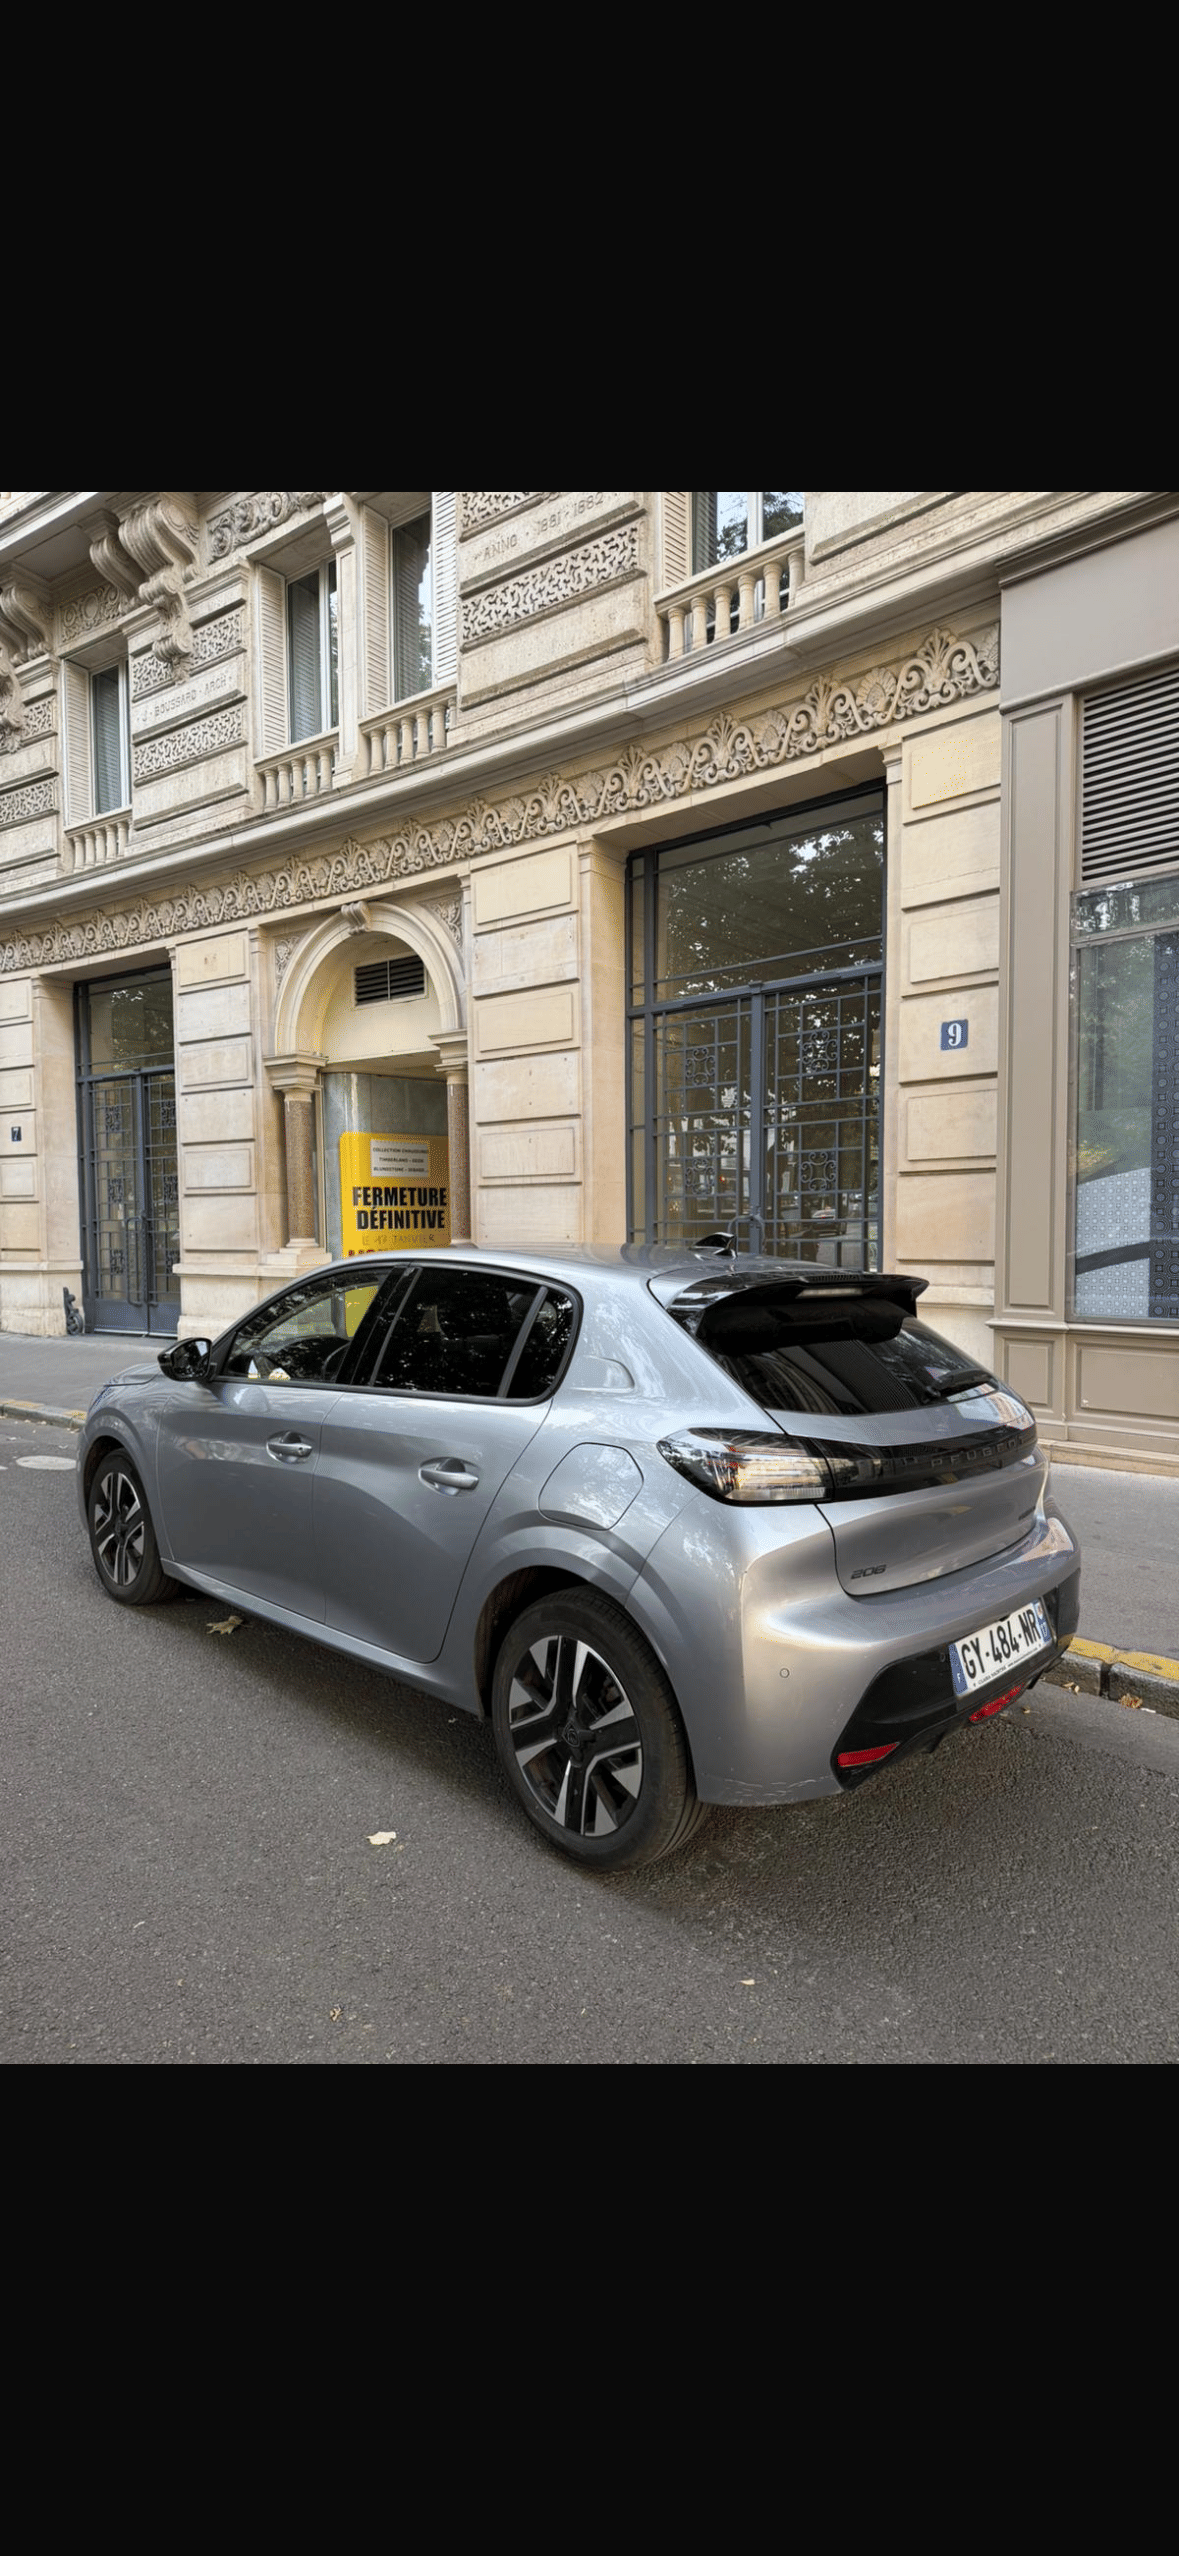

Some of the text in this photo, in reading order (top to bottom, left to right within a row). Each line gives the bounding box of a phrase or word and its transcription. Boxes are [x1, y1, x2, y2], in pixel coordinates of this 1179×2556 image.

[948, 1023, 962, 1046] 9
[352, 1187, 447, 1206] FERMETURE
[357, 1207, 445, 1229] DÉFINITIVE
